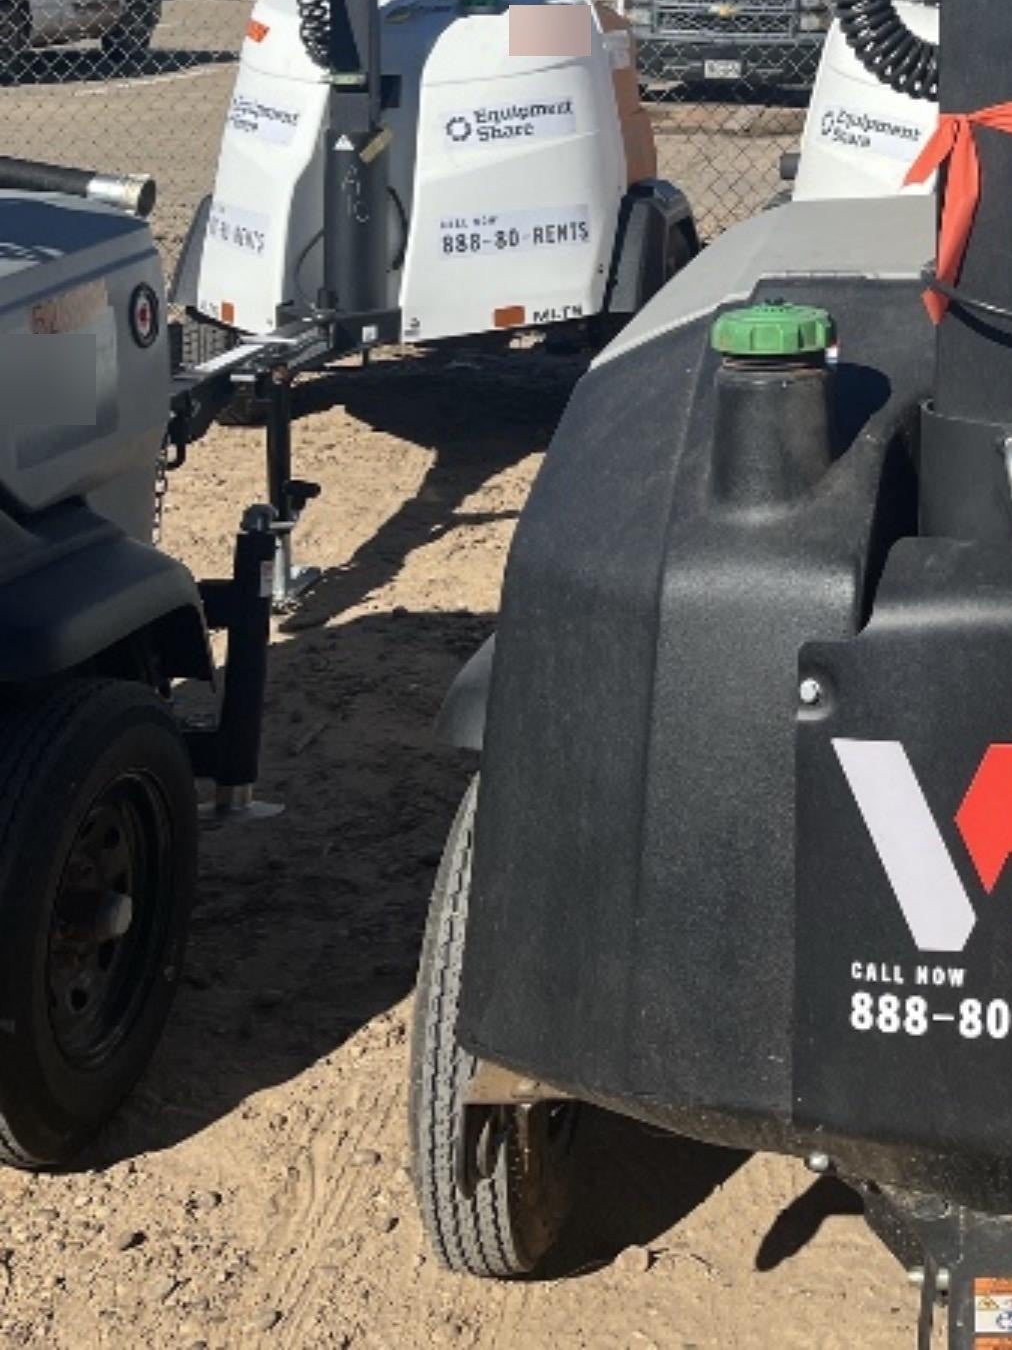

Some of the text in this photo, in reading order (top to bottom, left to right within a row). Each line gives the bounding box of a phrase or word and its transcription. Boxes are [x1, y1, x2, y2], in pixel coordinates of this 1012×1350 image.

[473, 101, 574, 125] Equipment
[476, 122, 535, 142] Share
[851, 960, 967, 988] CALL NOW
